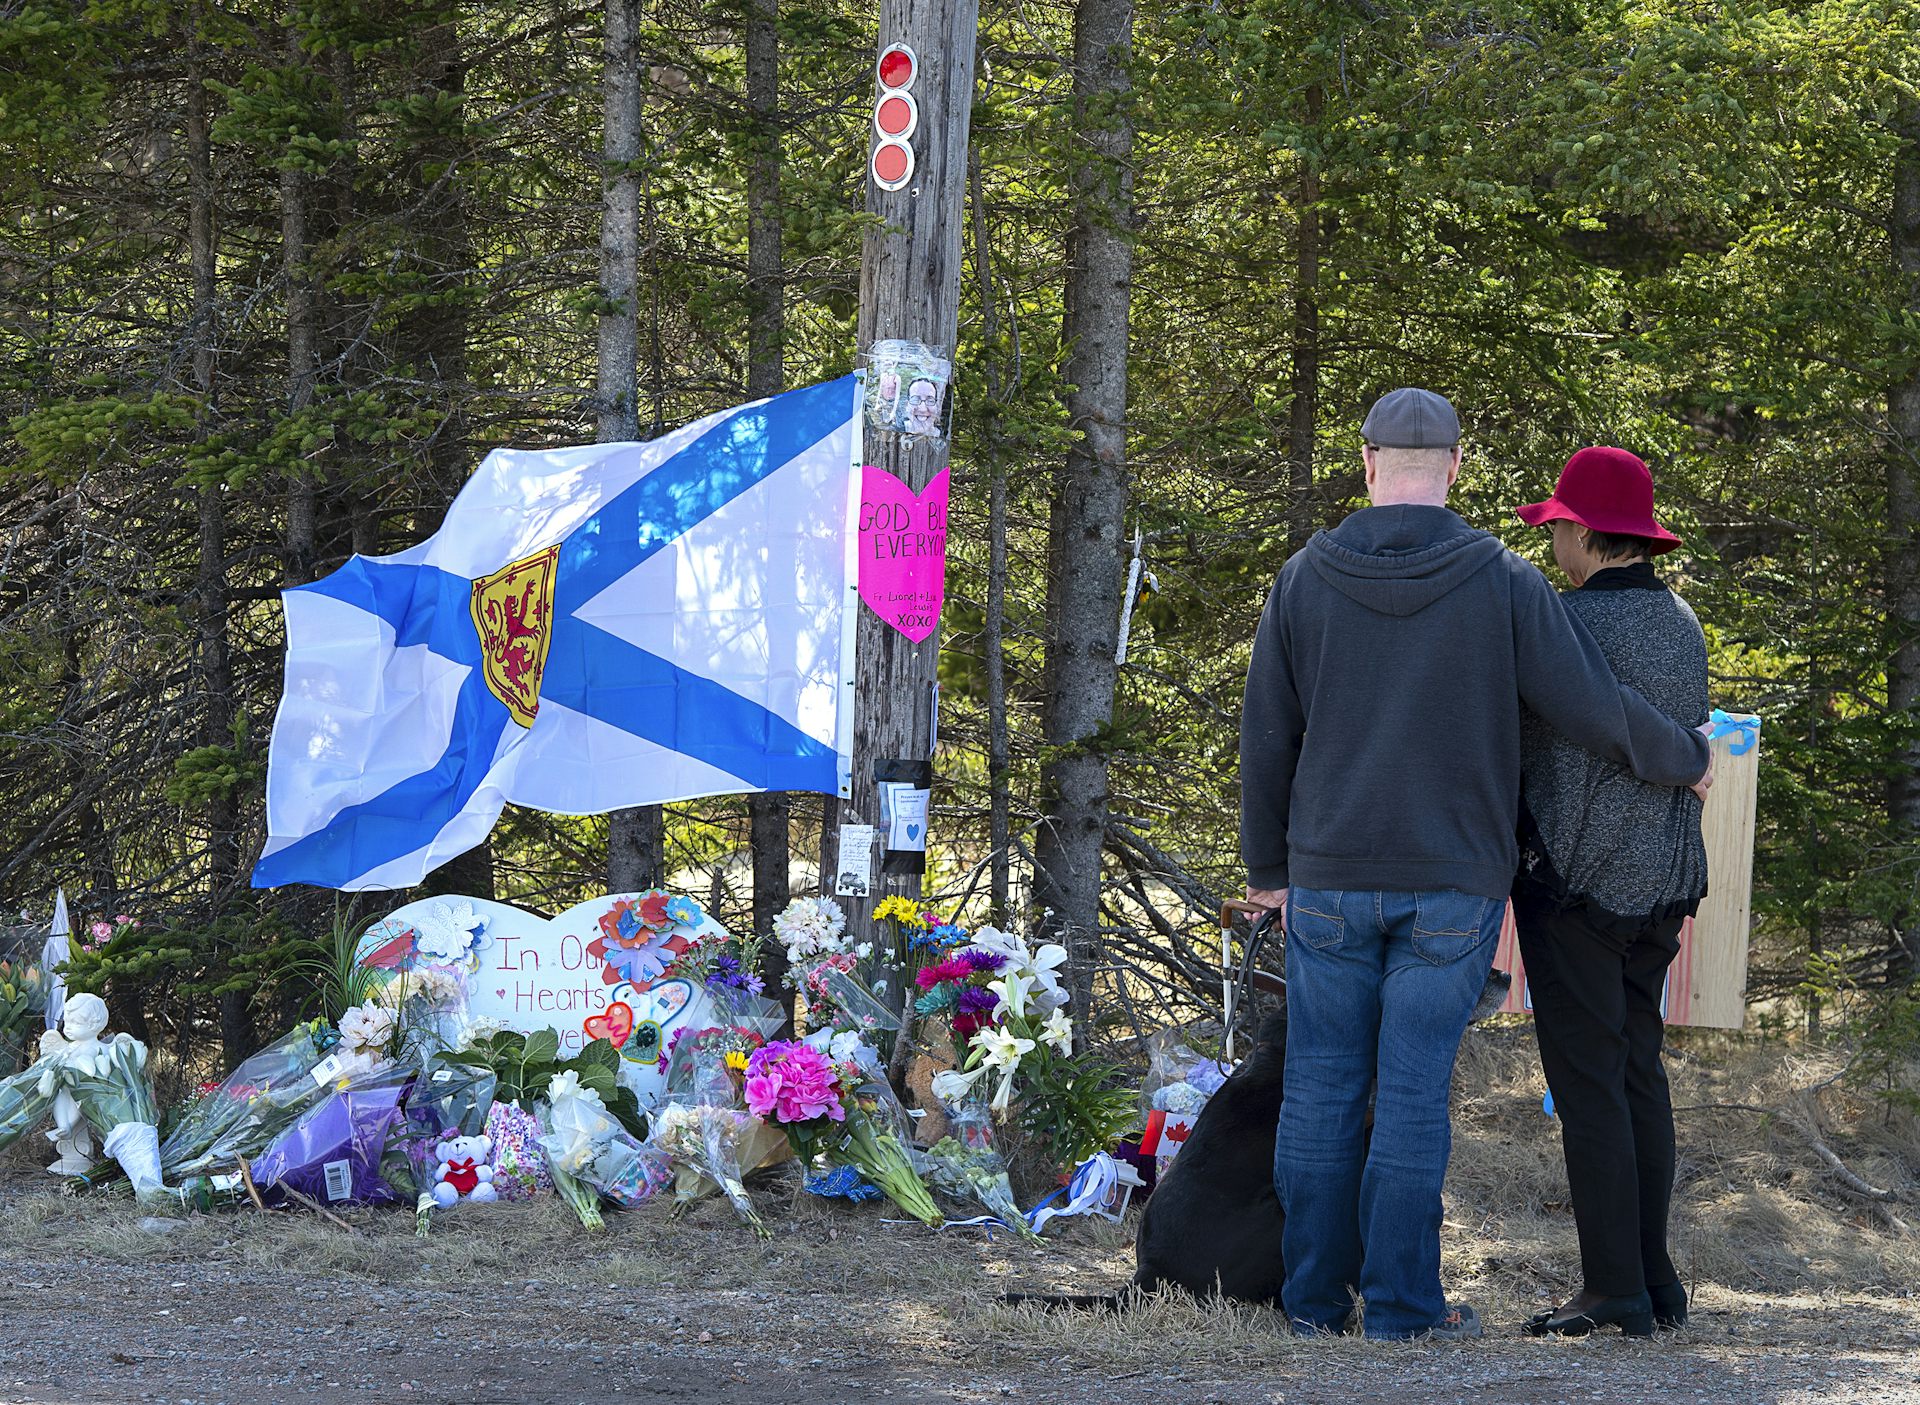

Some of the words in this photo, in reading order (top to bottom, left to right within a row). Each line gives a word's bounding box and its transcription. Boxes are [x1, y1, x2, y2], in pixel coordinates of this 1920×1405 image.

[859, 502, 910, 531] GOD
[928, 501, 946, 531] BL
[874, 532, 945, 560] EVERYON
[888, 592, 917, 602] Lionel
[897, 613, 933, 627] XOXO
[496, 937, 539, 971] In
[515, 979, 606, 1013] Hearts
